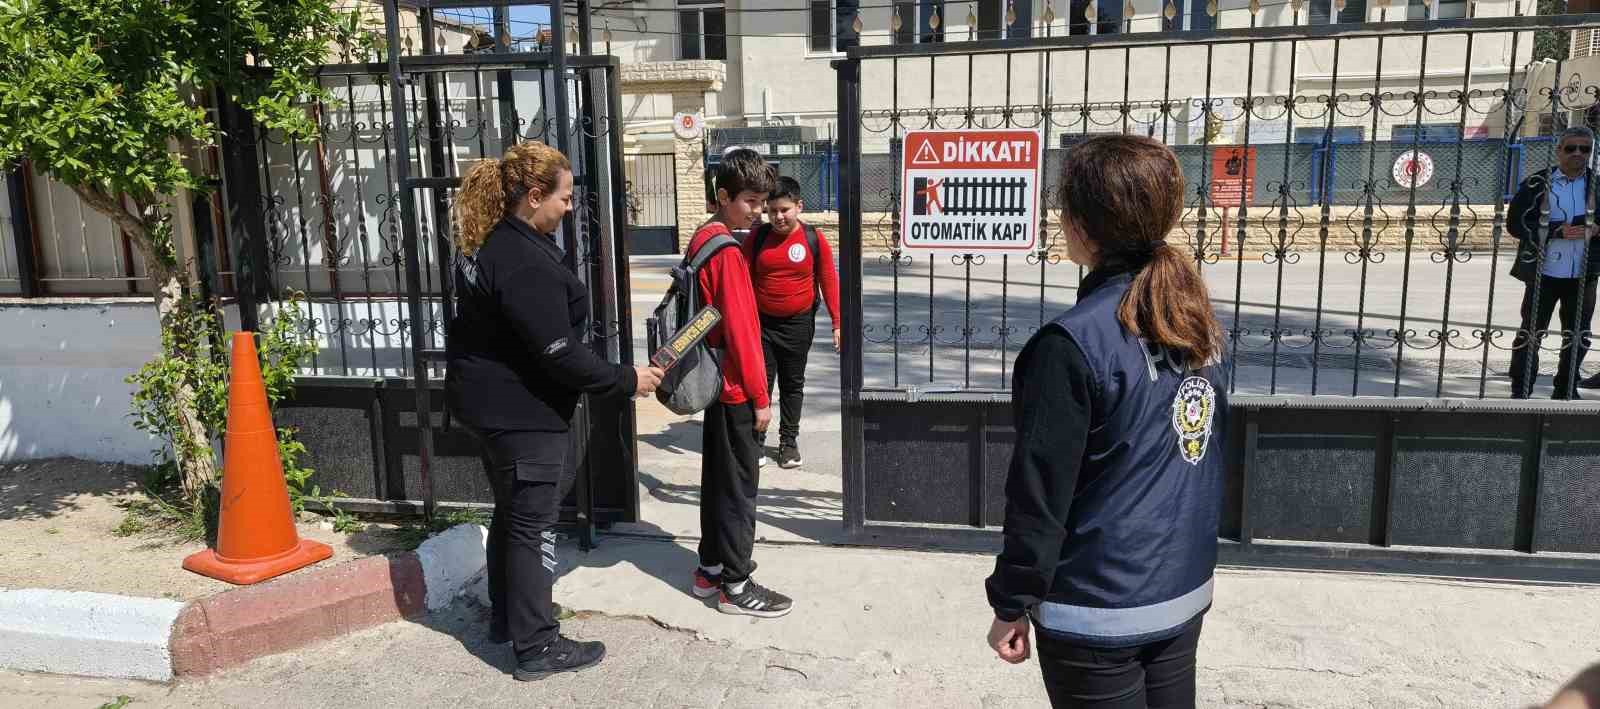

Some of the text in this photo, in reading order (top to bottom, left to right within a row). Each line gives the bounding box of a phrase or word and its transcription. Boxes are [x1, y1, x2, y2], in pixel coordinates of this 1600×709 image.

[943, 136, 1031, 163] DİKKAT!
[911, 218, 1027, 241] OTOMATİK KAPI
